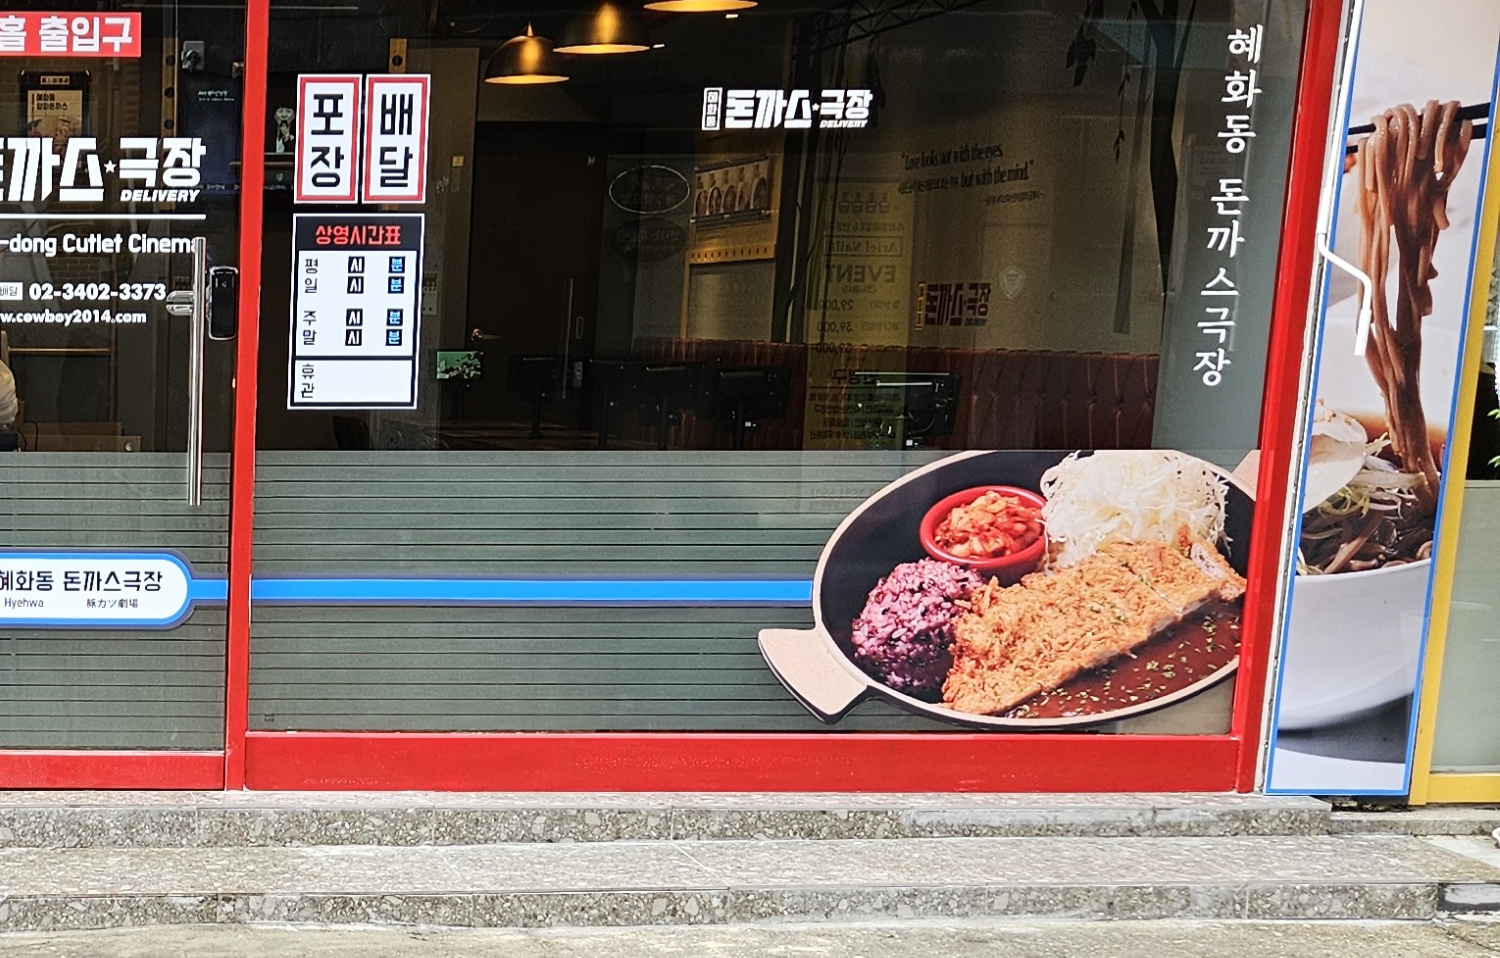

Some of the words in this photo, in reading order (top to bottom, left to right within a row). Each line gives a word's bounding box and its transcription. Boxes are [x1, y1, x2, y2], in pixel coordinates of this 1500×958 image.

[38, 15, 133, 53] 출입구
[1215, 23, 1265, 155] 혜화동
[725, 89, 812, 129] 돈까스
[819, 89, 874, 120] 극장
[309, 93, 345, 189] 포장
[377, 93, 414, 189] 배달
[119, 137, 206, 187] 극장
[120, 190, 200, 203] DELIVERY
[62, 232, 123, 254] Cutlet
[315, 225, 402, 246] 상영시간표
[304, 258, 319, 294] 평일
[350, 258, 363, 273] 시
[29, 284, 166, 300] 02-3402-3373
[349, 278, 362, 292] 시
[1191, 177, 1250, 388] 돈까스극장
[302, 310, 318, 346] 주말
[348, 311, 361, 325] 시
[347, 331, 360, 345] 시
[301, 363, 315, 399] 휴관
[63, 570, 163, 592] 돈까스극장
[4, 597, 44, 609] Hyehwa
